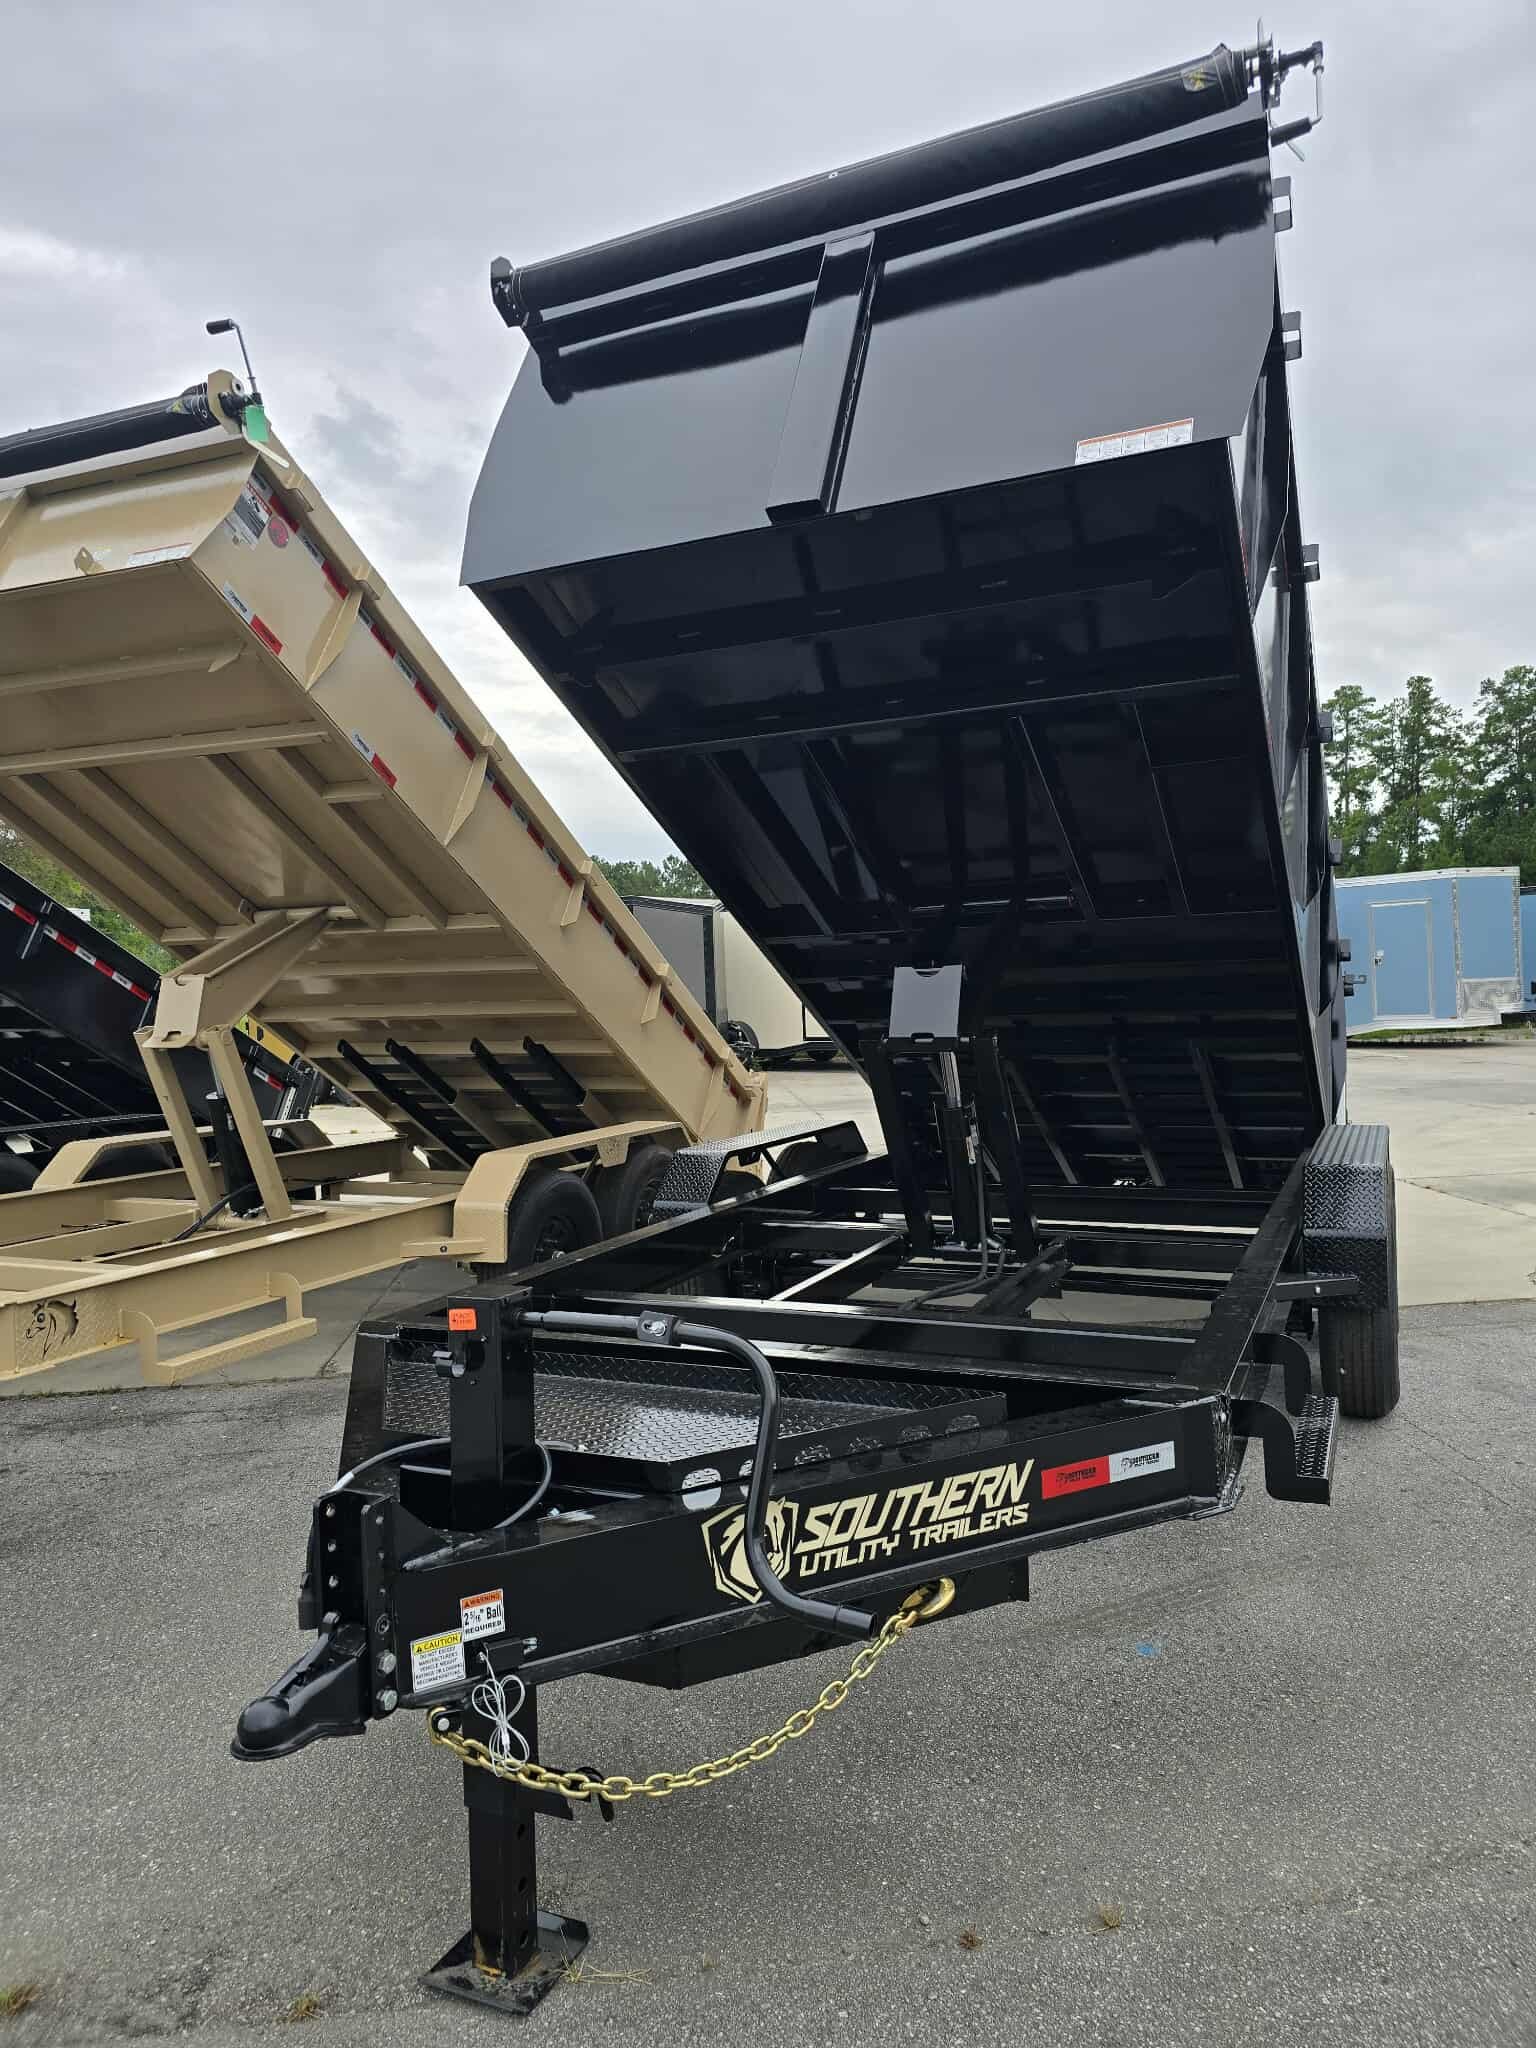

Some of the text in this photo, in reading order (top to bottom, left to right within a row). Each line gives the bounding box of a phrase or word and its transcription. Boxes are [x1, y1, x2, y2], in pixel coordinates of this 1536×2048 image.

[794, 1459, 1035, 1555] SOUTHERN
[799, 1503, 1030, 1577] UTILITY TRAILERS
[470, 1592, 500, 1604] WARNING
[464, 1613, 469, 1625] 2
[487, 1602, 501, 1620] Ball
[464, 1620, 502, 1634] REQUIRED
[423, 1634, 458, 1649] CAUTION
